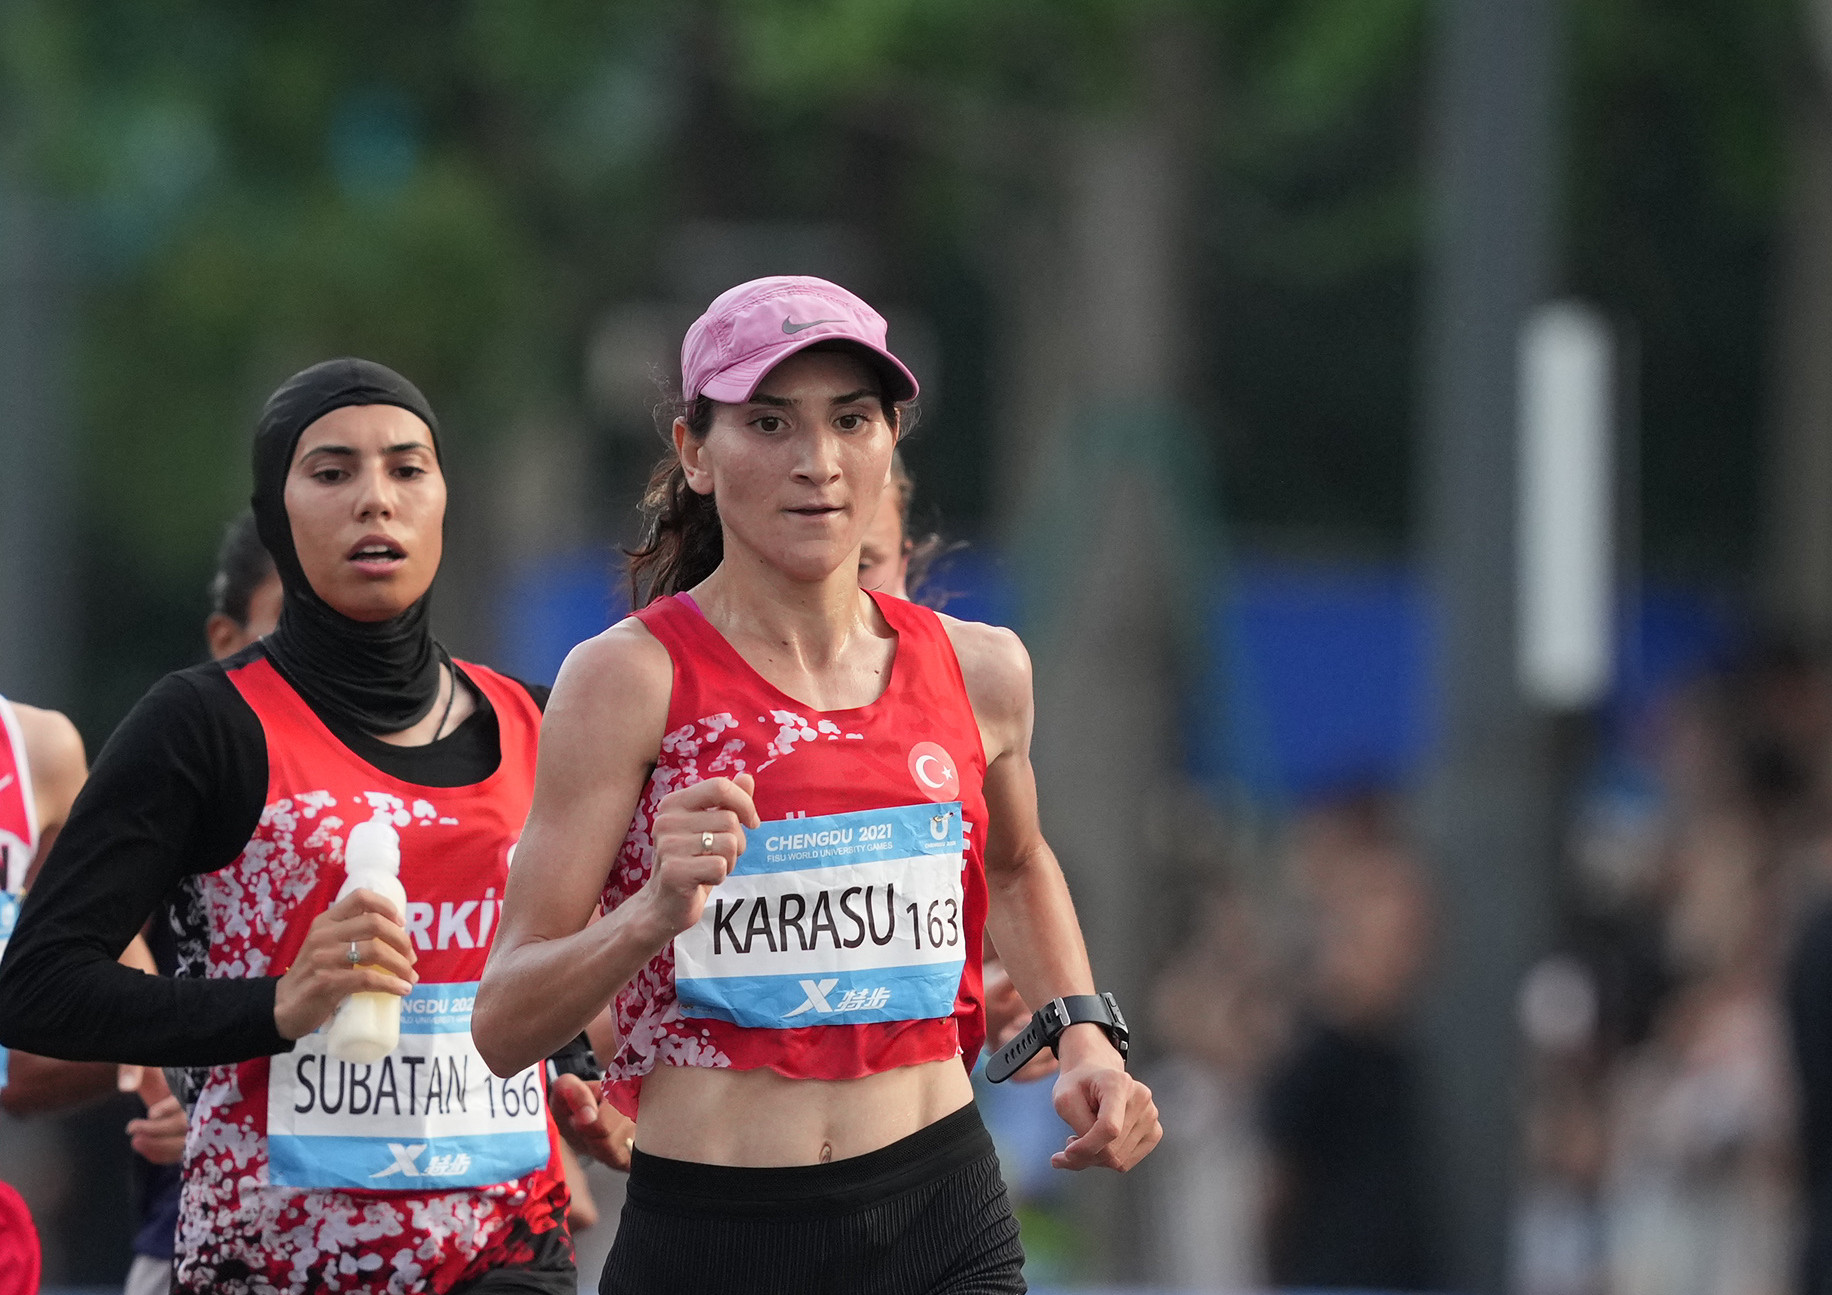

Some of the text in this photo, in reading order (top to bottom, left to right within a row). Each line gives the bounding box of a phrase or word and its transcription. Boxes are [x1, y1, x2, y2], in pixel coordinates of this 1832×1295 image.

[765, 823, 893, 852] CHENGDU 2021
[766, 841, 893, 863] FISU WORLD UNIVERSITY GAMES
[714, 883, 958, 955] KARASU 163
[400, 996, 475, 1014] NGDU 202
[294, 1054, 540, 1119] SUBATAN 166
